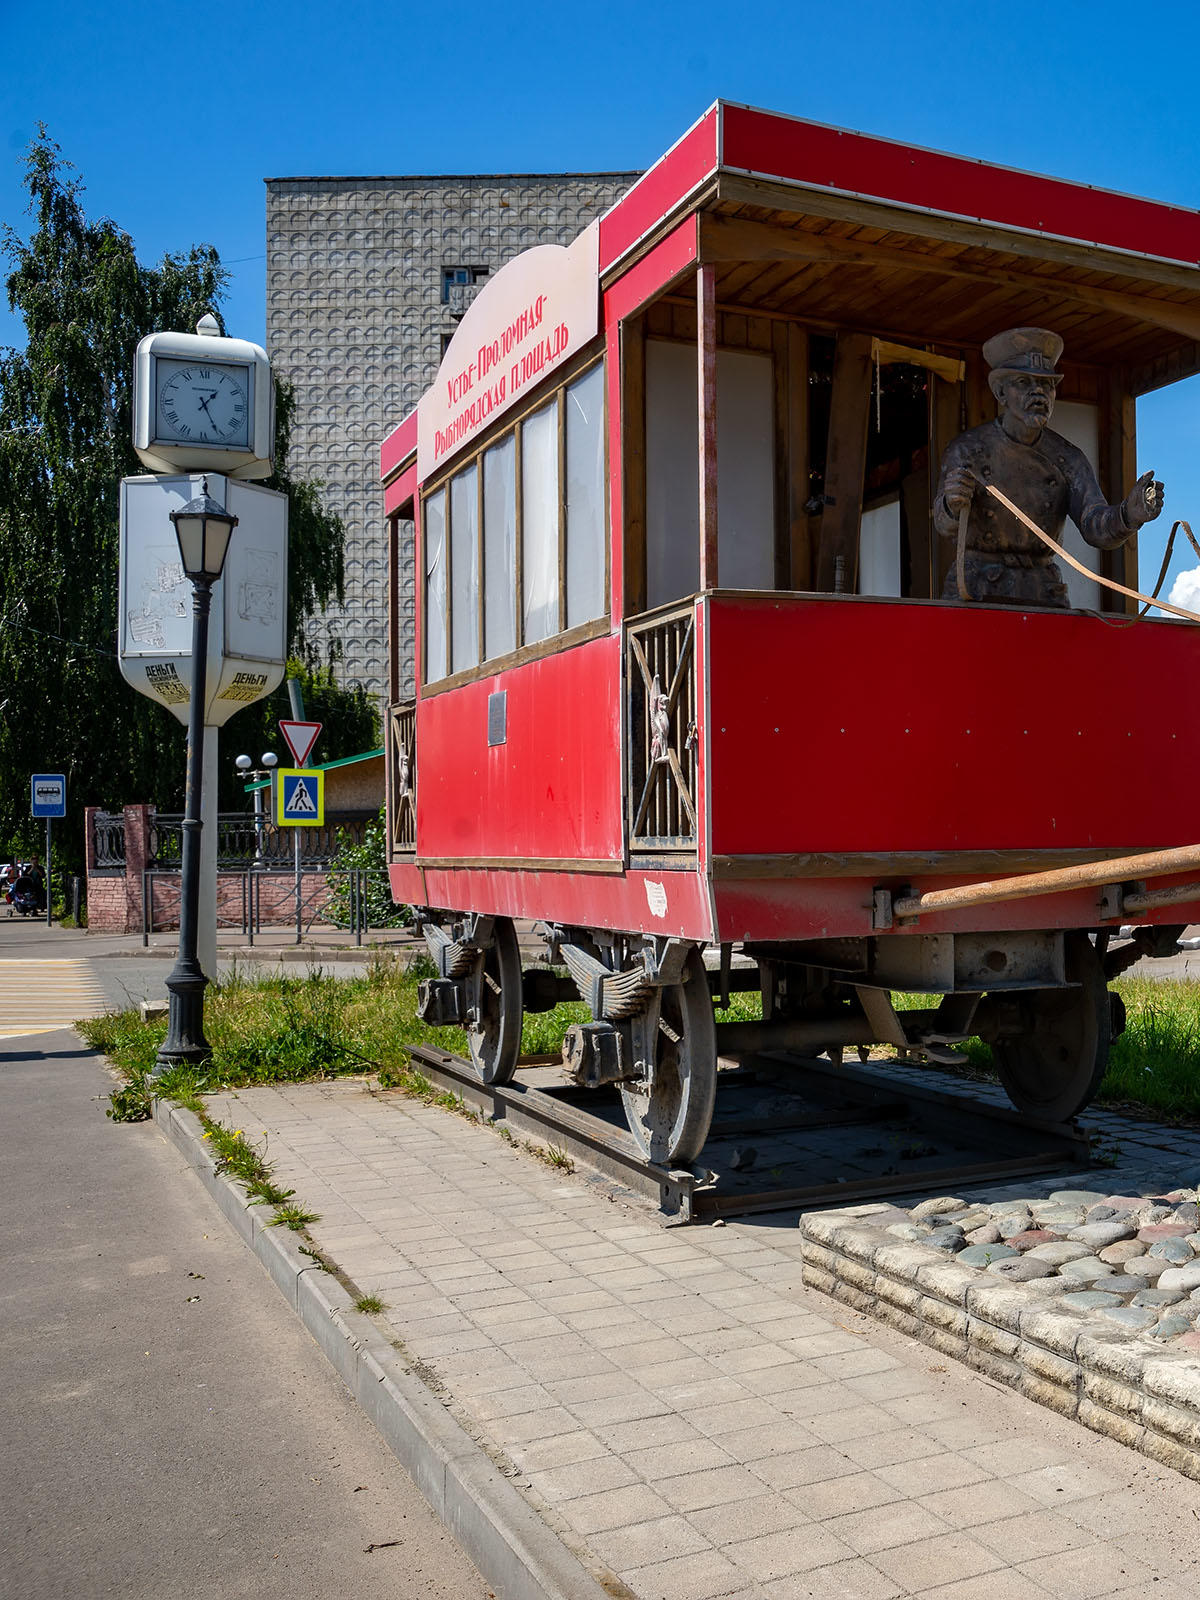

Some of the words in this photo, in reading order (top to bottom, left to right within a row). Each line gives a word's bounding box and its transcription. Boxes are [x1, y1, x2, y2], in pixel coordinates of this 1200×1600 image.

[434, 375, 506, 461] РЫБНОРЯДСКАЯ
[510, 322, 569, 394] ПЛОЩАДЬ
[145, 662, 177, 677] ДЕНЬГИ
[231, 672, 268, 686] ДЕНЬГИ
